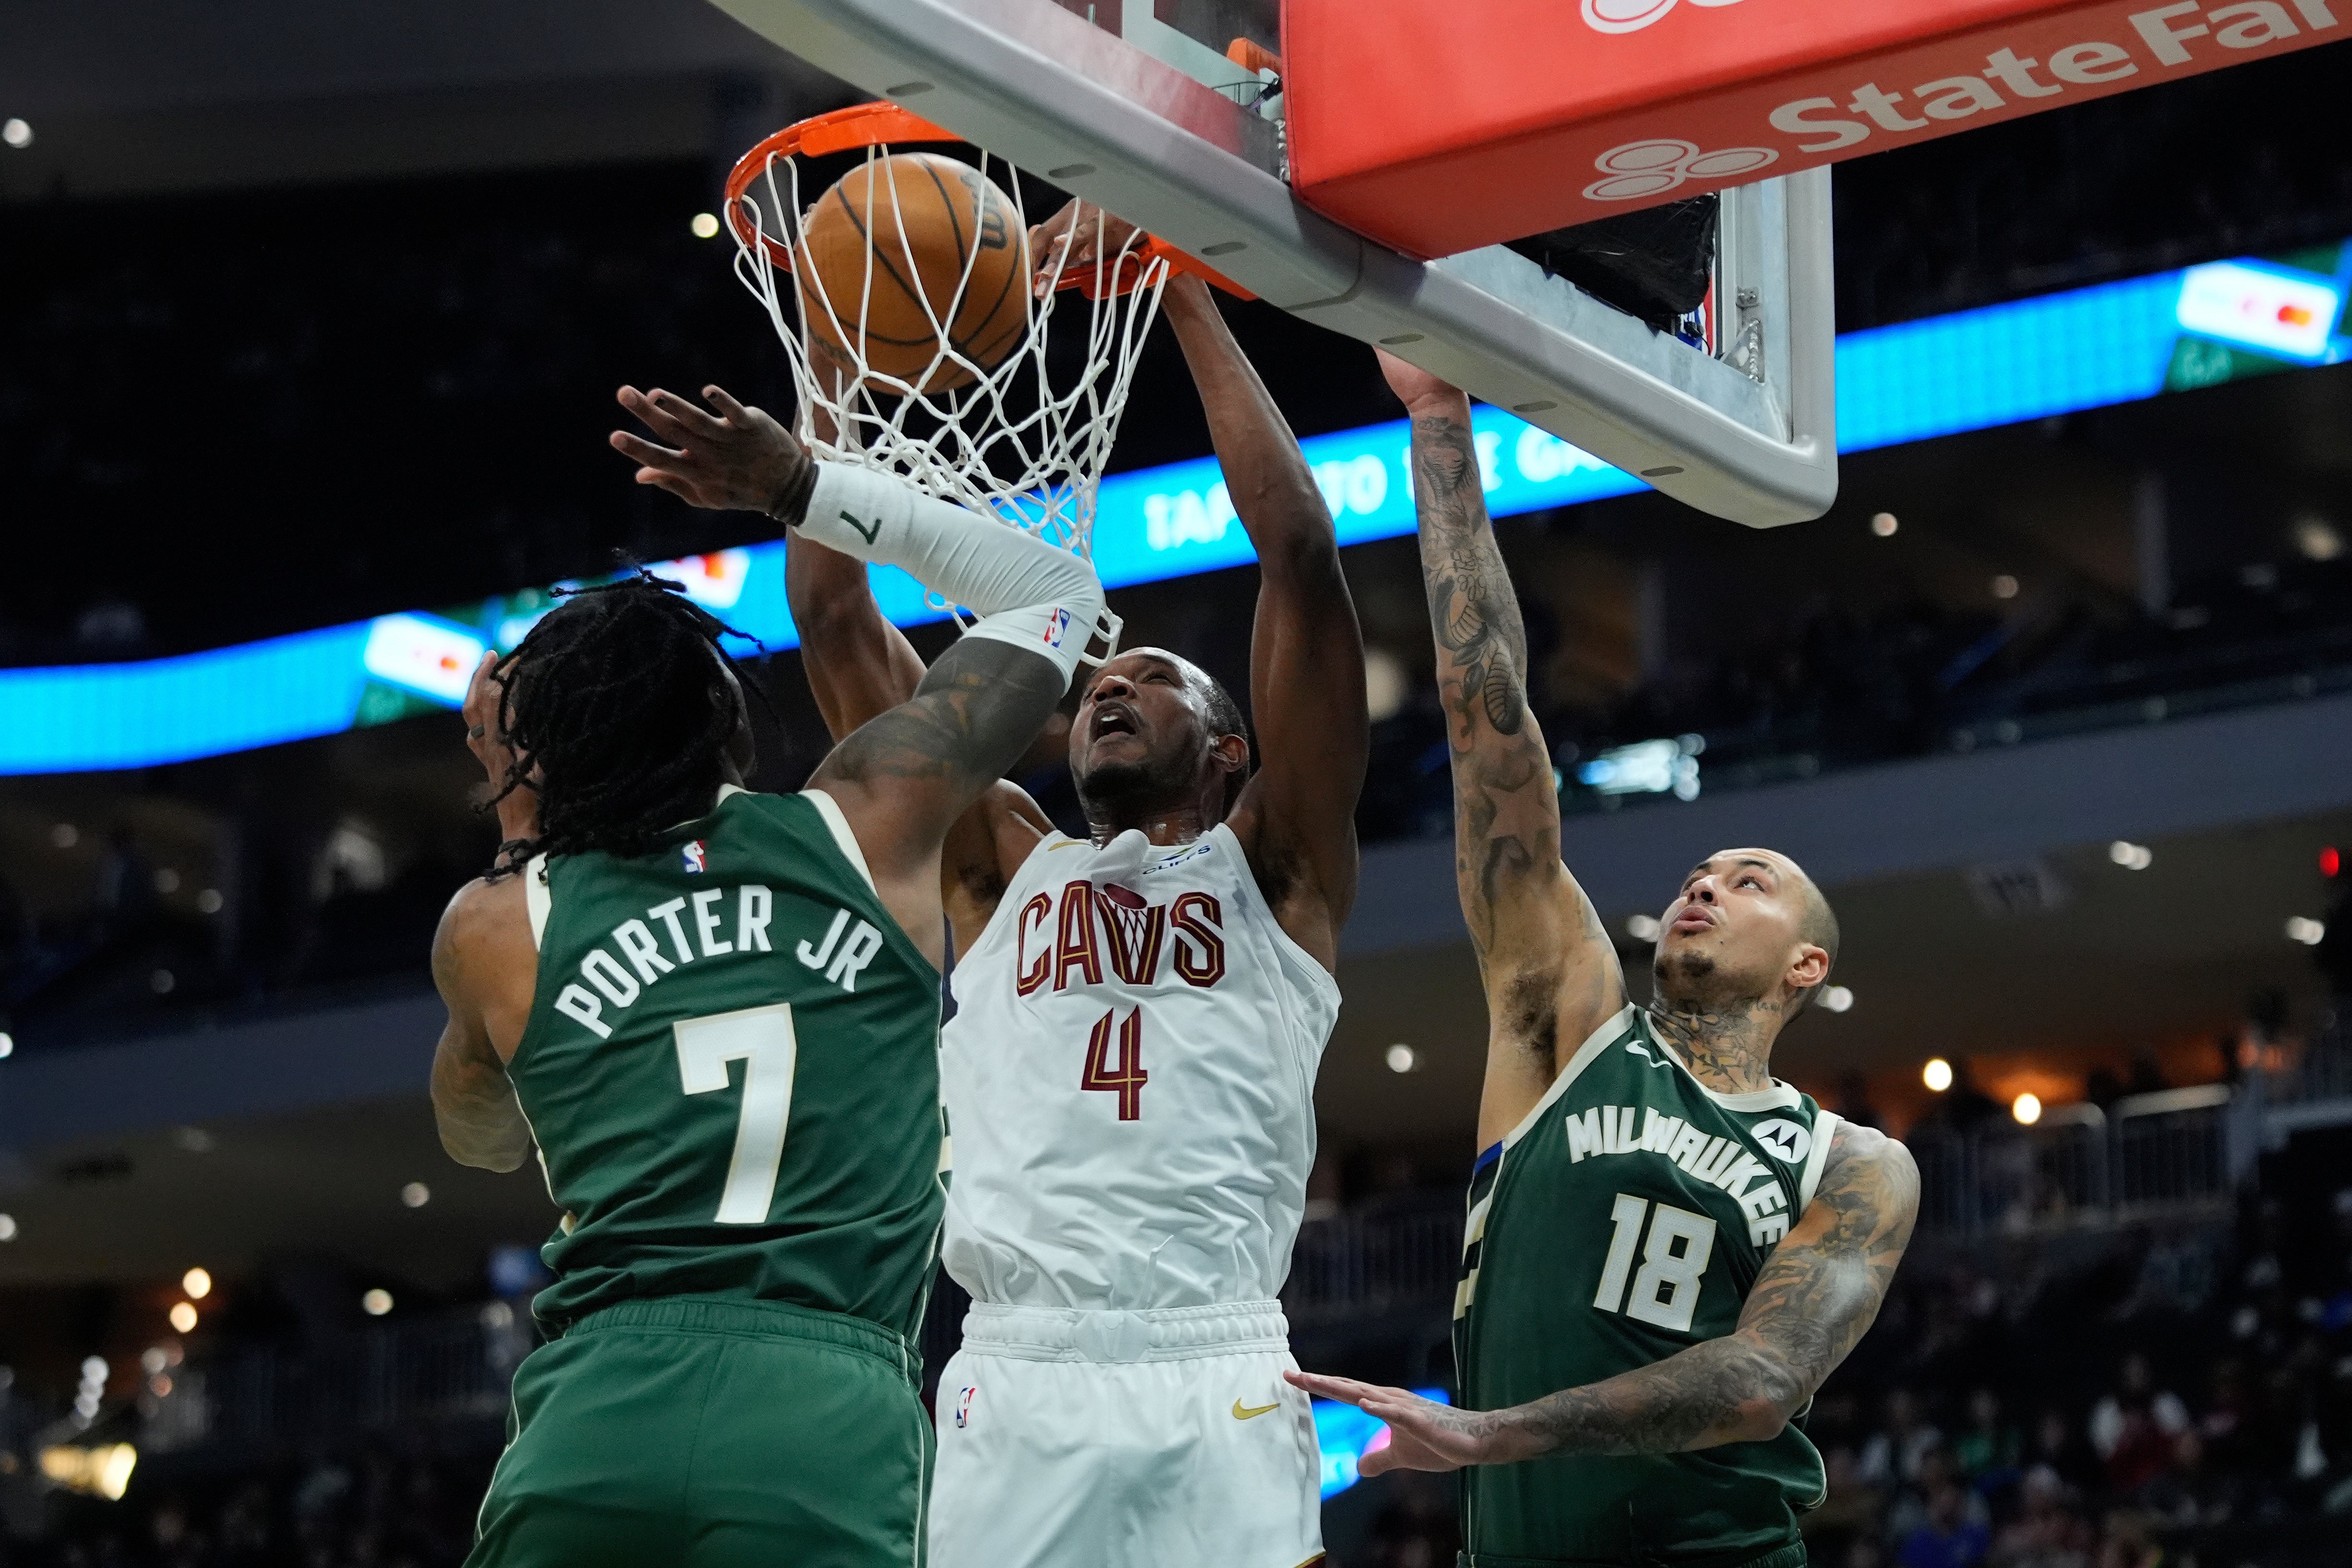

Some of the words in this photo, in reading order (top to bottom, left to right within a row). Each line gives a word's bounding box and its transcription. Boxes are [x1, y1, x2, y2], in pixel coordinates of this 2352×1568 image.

[553, 884, 772, 1039] PORTER
[796, 908, 883, 993] JR
[1017, 880, 1226, 998] CAVS
[673, 1002, 797, 1224] 7
[1081, 1005, 1149, 1121] 4
[1565, 1104, 1790, 1248] MILWAUKEE
[1593, 1192, 1717, 1333] 18
